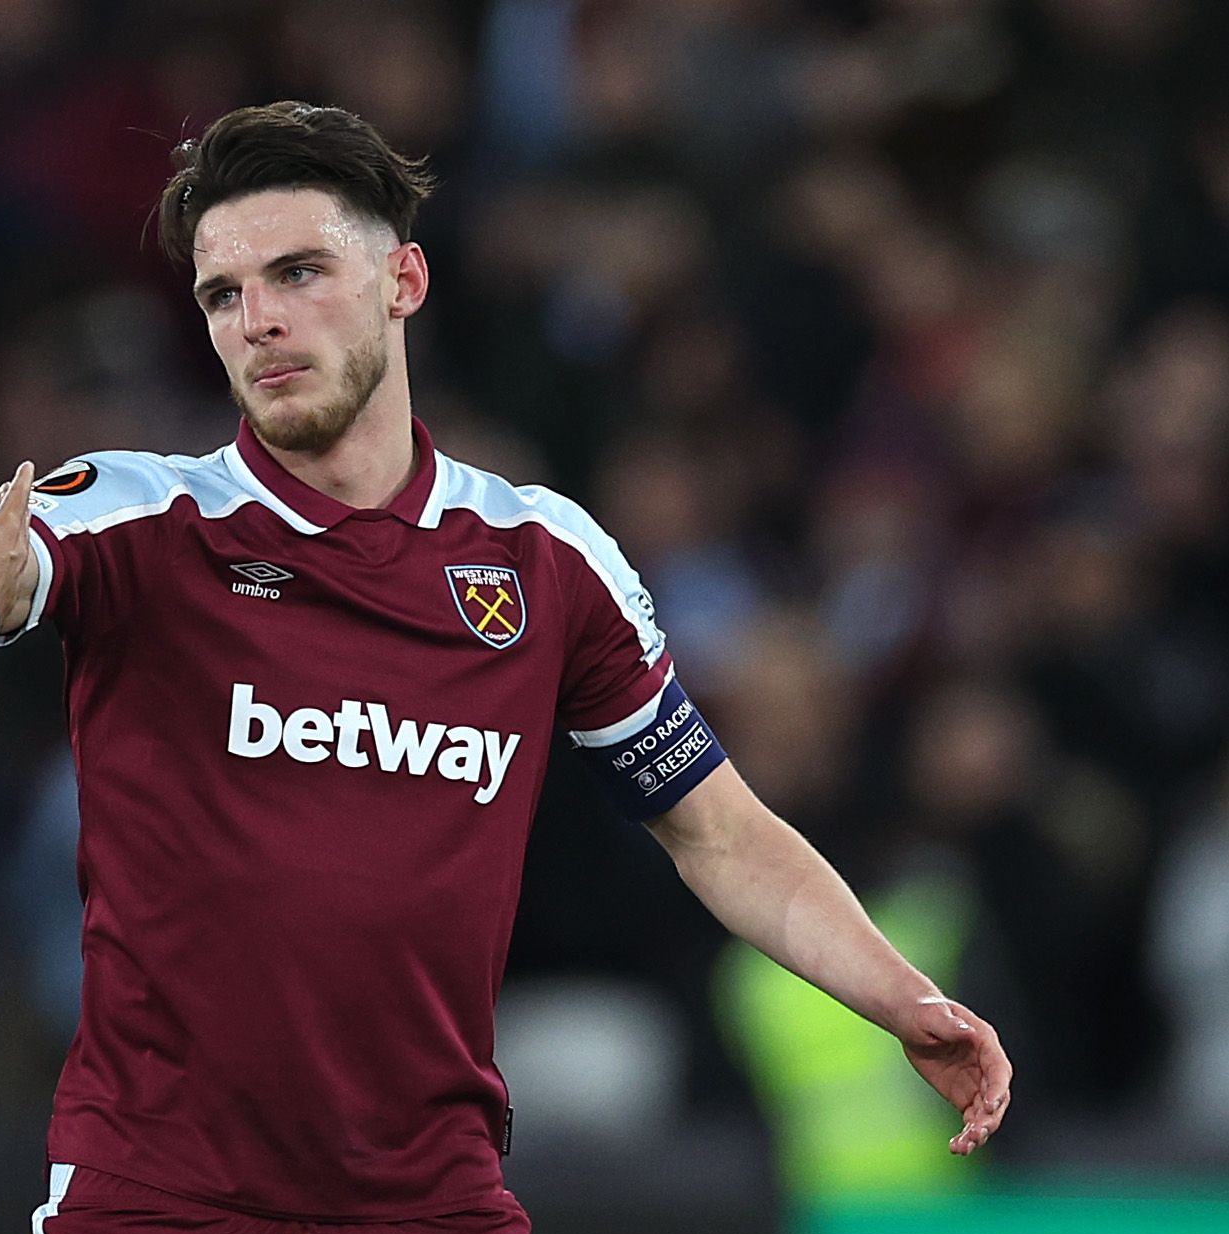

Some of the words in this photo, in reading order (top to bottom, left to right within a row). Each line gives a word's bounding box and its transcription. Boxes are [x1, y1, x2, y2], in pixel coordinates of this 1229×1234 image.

[232, 582, 281, 600] umbro
[453, 569, 482, 579] WEST
[483, 570, 512, 582] HAM
[467, 577, 501, 586] UNITED
[227, 682, 521, 805] betway
[612, 751, 636, 772] NO
[633, 735, 657, 756] TO
[655, 699, 693, 741] RACISM
[656, 726, 709, 778] RESPECT
